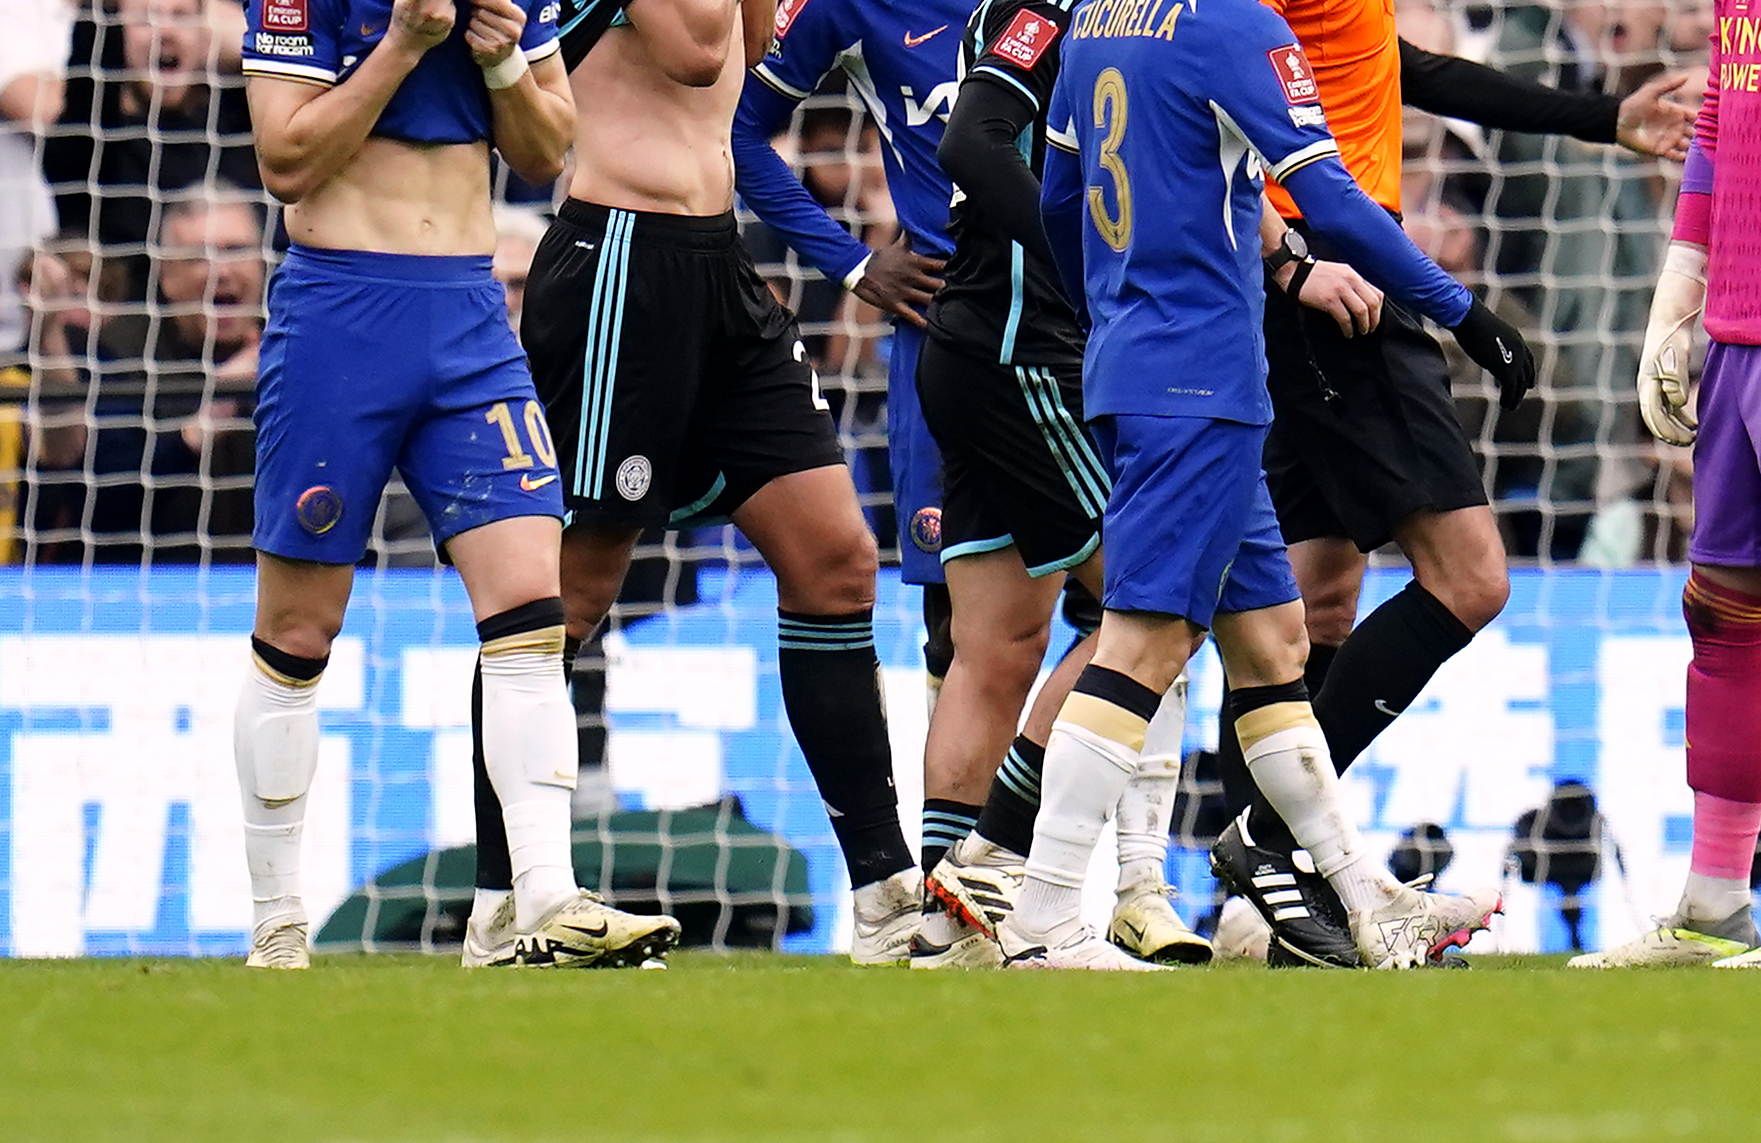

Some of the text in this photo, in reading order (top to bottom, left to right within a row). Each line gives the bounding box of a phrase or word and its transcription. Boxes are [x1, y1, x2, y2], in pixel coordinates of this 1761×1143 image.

[256, 32, 307, 46] No room
[281, 15, 302, 25] CUP
[1089, 66, 1133, 254] 3
[485, 400, 556, 471] 10
